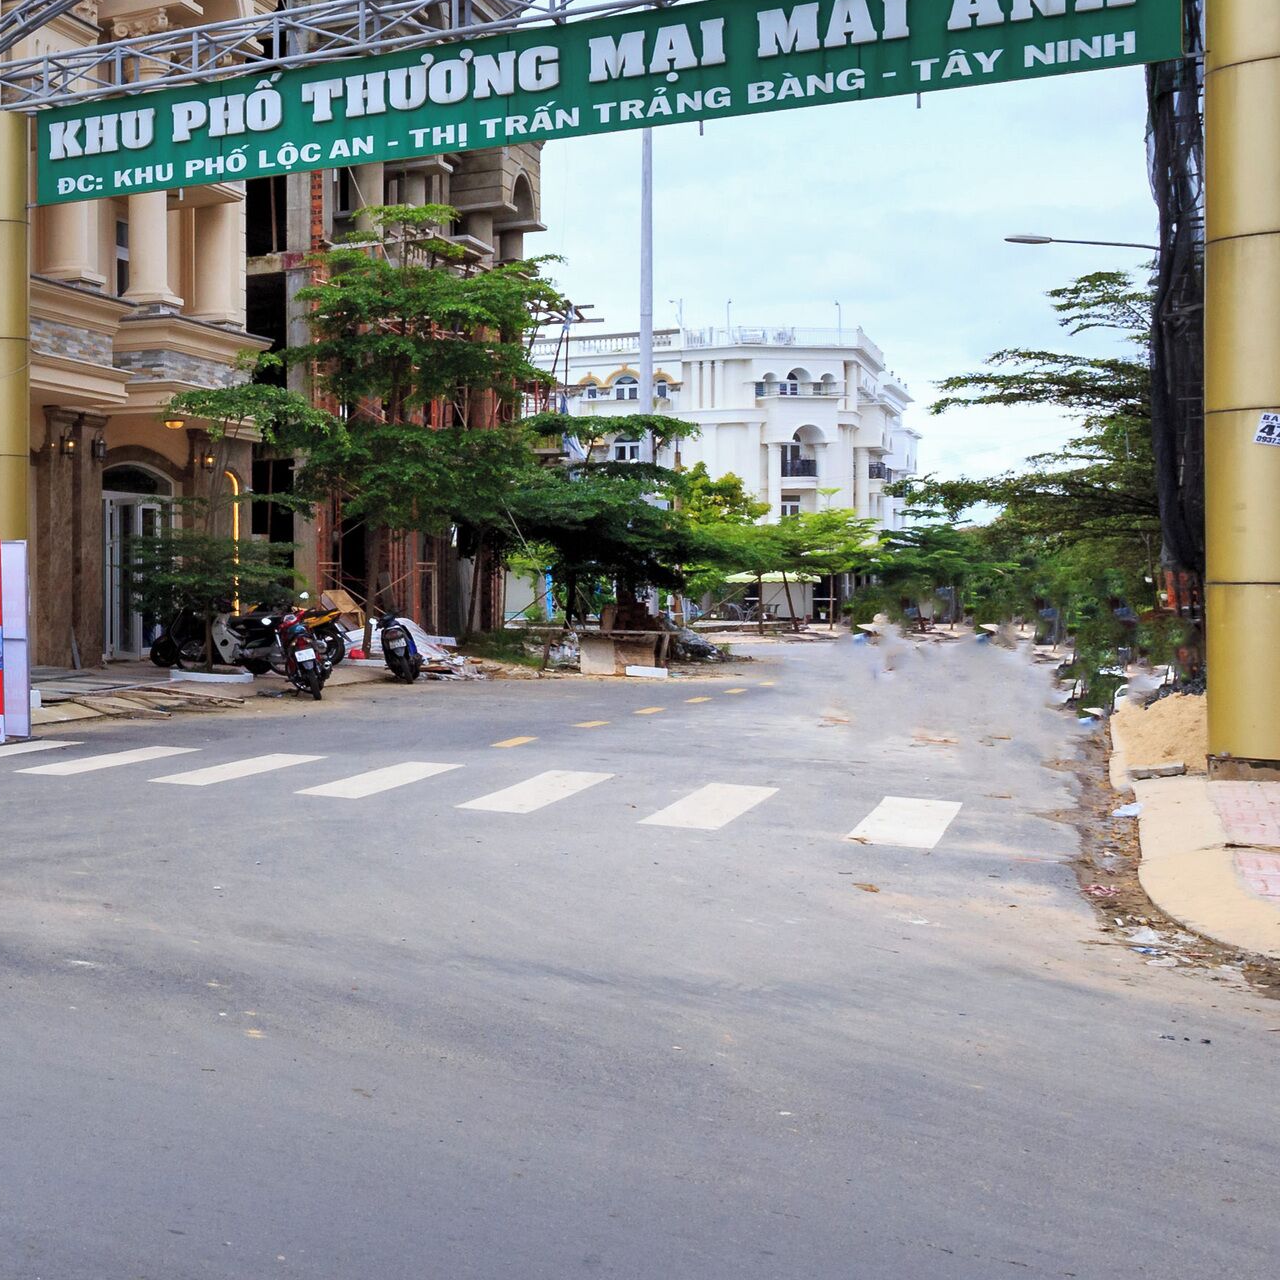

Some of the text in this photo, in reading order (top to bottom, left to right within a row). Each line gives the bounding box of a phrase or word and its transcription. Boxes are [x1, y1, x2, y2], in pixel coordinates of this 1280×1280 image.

[48, 105, 156, 161] KHU
[171, 71, 284, 143] PHỐ
[301, 45, 560, 124] THƯƠNG
[588, 17, 726, 85] MẠI
[57, 31, 1137, 196] ĐC: KHU PHỐ LỘC AN THỊ TRẤN TRẢNG BÀNG TÂY NINH
